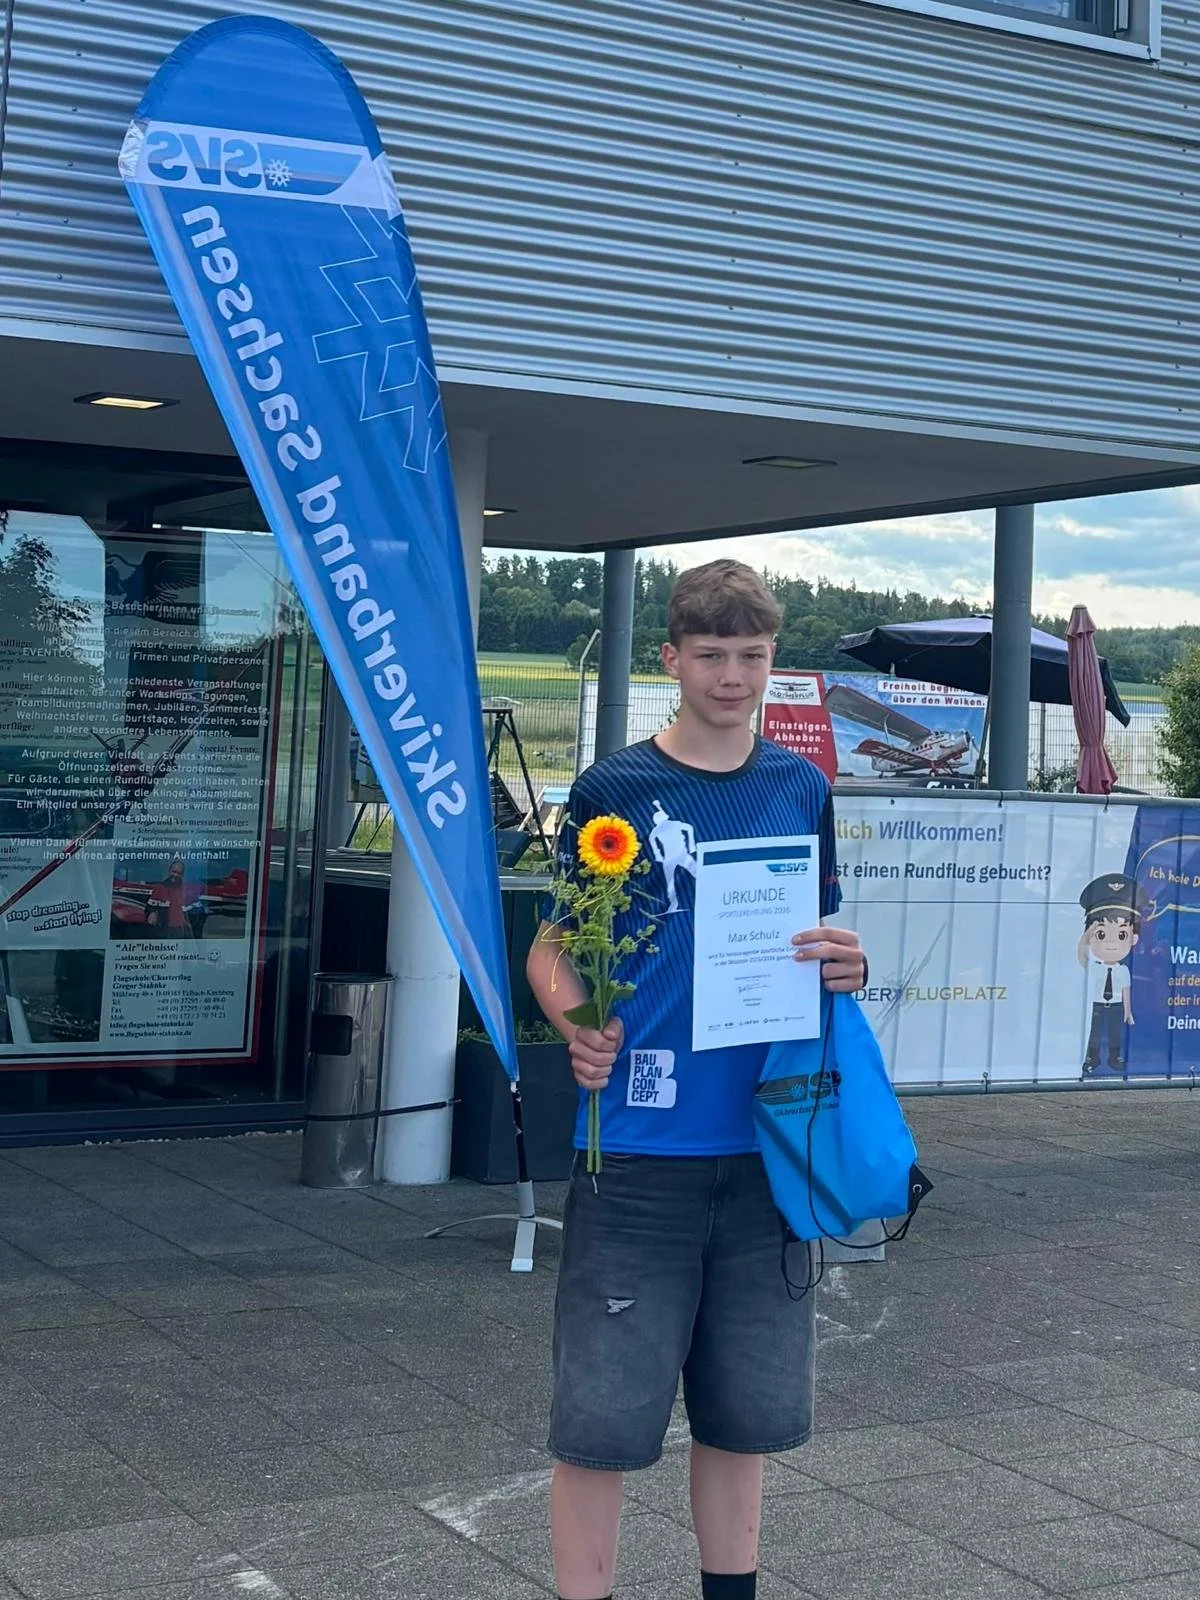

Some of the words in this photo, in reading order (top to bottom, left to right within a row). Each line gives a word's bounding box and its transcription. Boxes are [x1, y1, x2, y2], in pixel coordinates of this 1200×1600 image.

[152, 628, 190, 638] Bereich
[133, 652, 168, 662] Firmen
[171, 653, 189, 662] und
[23, 672, 44, 682] Hier
[47, 672, 85, 683] können
[107, 676, 184, 687] verschiedenste
[882, 681, 926, 691] Freiheit
[41, 687, 88, 698] abhalten,
[92, 687, 136, 698] darunter
[140, 689, 196, 700] Workshops,
[199, 691, 248, 703] Tagungen,
[892, 694, 917, 704] über
[921, 696, 940, 705] den
[944, 697, 986, 707] Wolken.
[154, 702, 200, 713] Jubiläen,
[203, 704, 271, 716] Sommerfeste,
[16, 710, 108, 722] Weihnachtsfeiern,
[112, 713, 177, 725] Geburtstage,
[241, 718, 269, 727] sowie
[53, 725, 89, 734] andere
[92, 726, 145, 736] besondere
[768, 720, 831, 733] Einsteigen.
[773, 732, 825, 743] Abheben.
[21, 748, 70, 760] Aufgrund
[73, 749, 104, 759] dieser
[147, 752, 160, 760] an
[163, 751, 196, 761] Events
[245, 752, 261, 762] die
[58, 759, 136, 773] Öffnungszeiten
[8, 773, 26, 783] Für
[29, 774, 61, 785] Gäste,
[64, 775, 80, 784] die
[83, 776, 111, 785] einen
[114, 776, 159, 787] Rundflug
[241, 778, 270, 787] bitten
[84, 788, 105, 797] sich
[108, 787, 131, 797] über
[134, 789, 150, 797] die
[153, 788, 187, 799] Klingel
[17, 799, 33, 809] Ein
[36, 800, 78, 811] Mitglied
[81, 801, 121, 810] unseres
[124, 801, 190, 811] Pilotenteams
[193, 801, 214, 810] wird
[217, 802, 233, 811] Sie
[235, 802, 260, 811] dann
[879, 820, 1004, 842] Willkommen!
[10, 837, 42, 847] Vielen
[111, 838, 170, 848] Verständnis
[173, 839, 193, 848] und
[195, 839, 211, 848] wir
[213, 839, 261, 849] wünschen
[75, 852, 103, 861] einen
[105, 852, 171, 863] angenehmen
[785, 862, 809, 873] SVS
[853, 860, 899, 878] einen
[904, 862, 976, 883] Rundflug
[979, 863, 1052, 884] gebucht?
[1149, 866, 1166, 879] Ich
[1168, 869, 1190, 885] hole
[722, 887, 786, 906] URKUNDE
[6, 908, 29, 923] stop
[728, 932, 748, 943] Max
[749, 929, 781, 941] Schulz
[1170, 945, 1200, 965] Wa
[112, 982, 137, 990] Gregor
[1167, 974, 1186, 986] auf
[905, 986, 1008, 1001] FLUGPLATZ
[1167, 993, 1192, 1006] oder
[635, 1053, 657, 1066] BAU
[633, 1065, 663, 1079] PLAN
[632, 1077, 656, 1091] CON
[631, 1090, 660, 1104] CEPT
